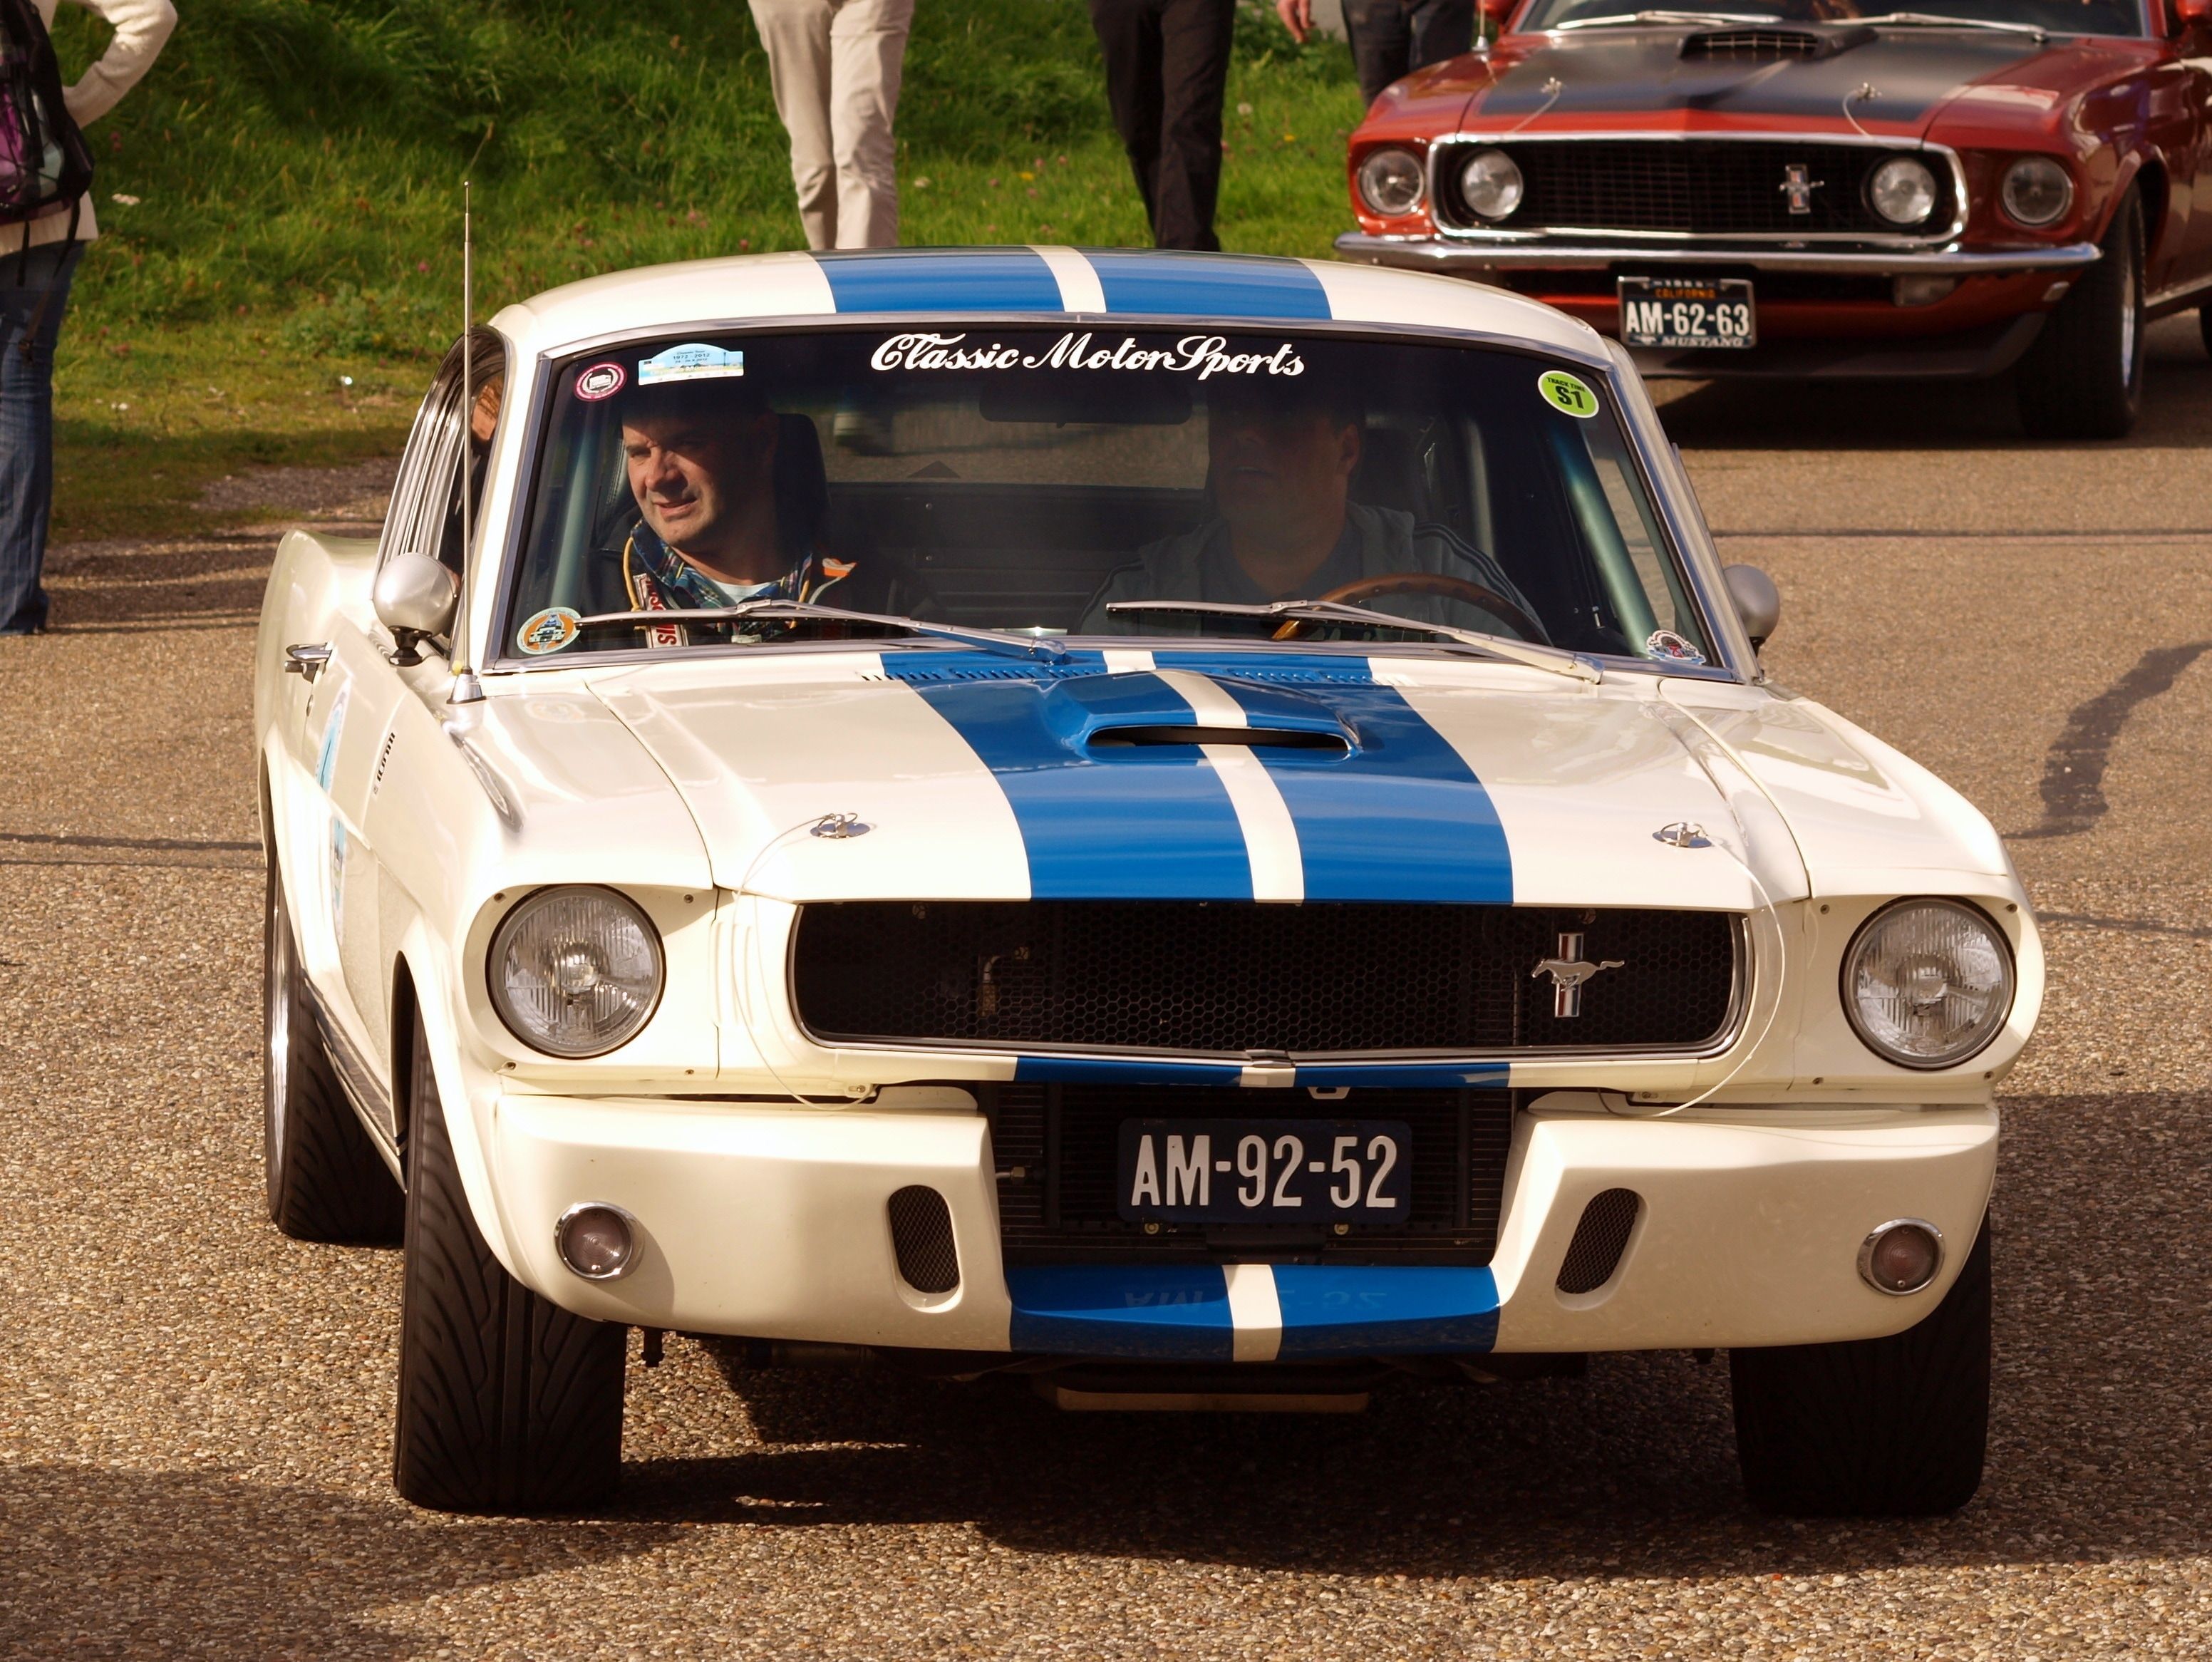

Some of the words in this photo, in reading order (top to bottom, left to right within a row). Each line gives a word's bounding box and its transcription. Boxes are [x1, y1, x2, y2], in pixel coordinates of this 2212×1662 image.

[1626, 301, 1750, 336] AM-62-63
[869, 332, 1020, 371] Classic
[1661, 335, 1745, 348] MUSTANG
[1555, 386, 1584, 409] S1
[1131, 1135, 1397, 1209] AM-92-52
